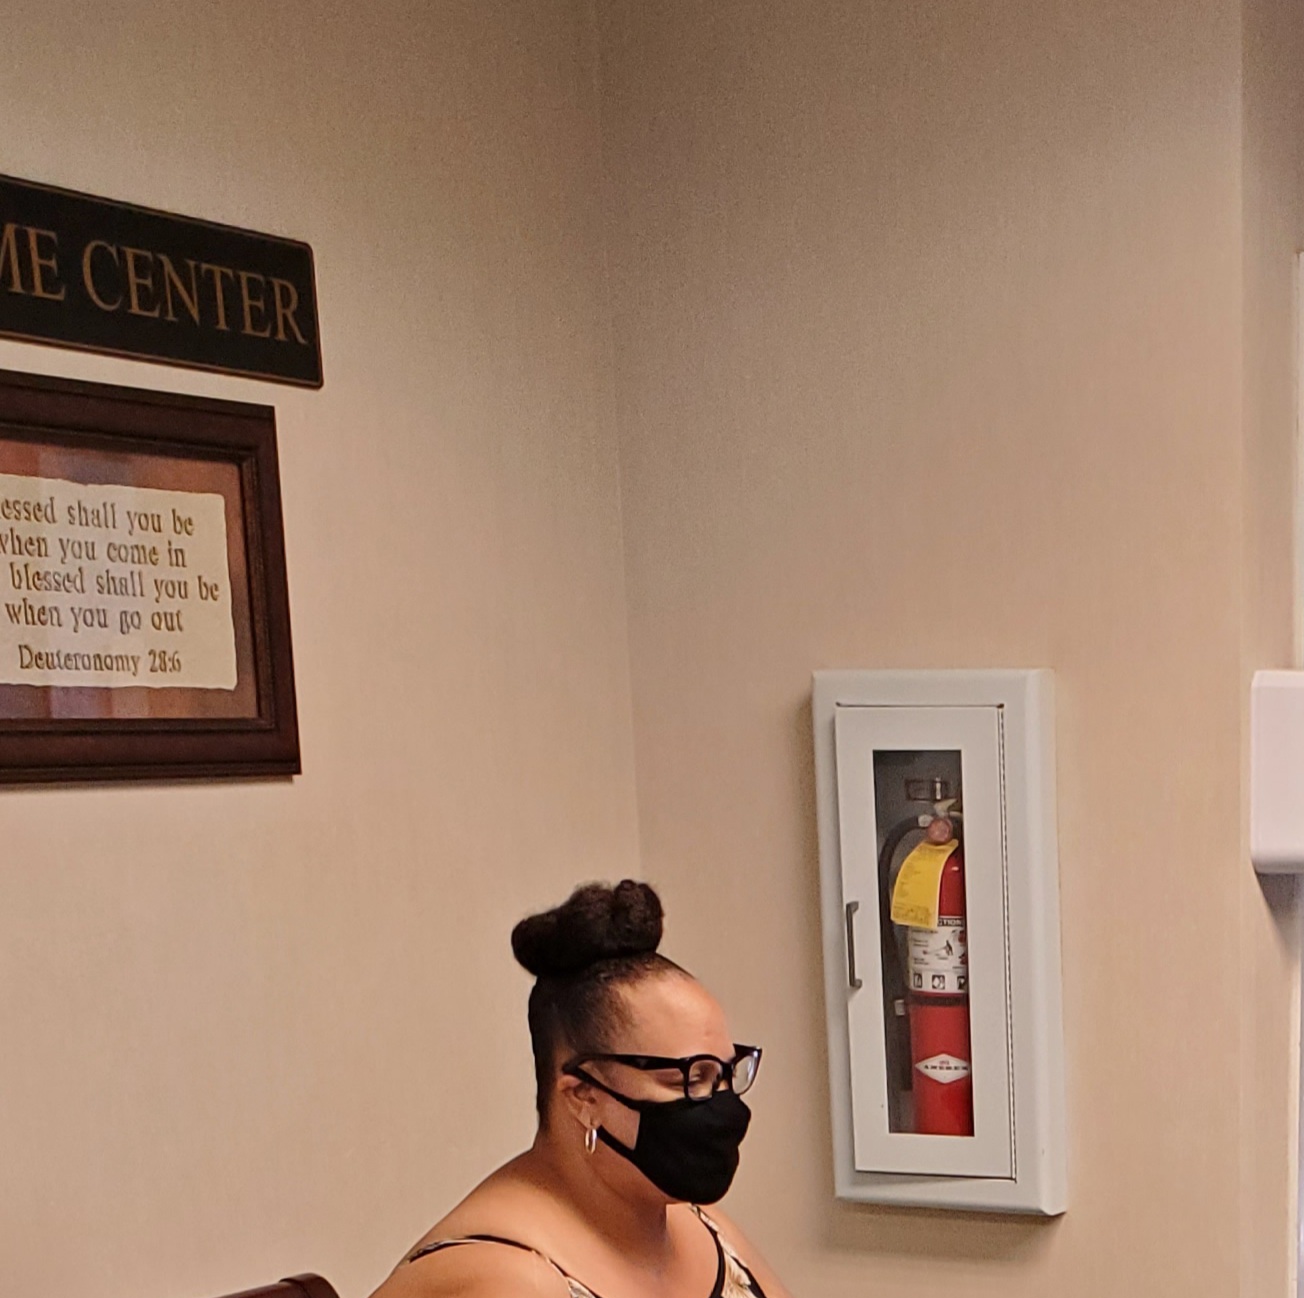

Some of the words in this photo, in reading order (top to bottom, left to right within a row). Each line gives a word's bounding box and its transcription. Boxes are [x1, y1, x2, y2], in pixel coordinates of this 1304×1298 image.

[82, 239, 308, 345] CENTER
[0, 496, 57, 524] essed
[67, 500, 117, 529] shall
[126, 510, 162, 536] you
[172, 508, 194, 536] be
[59, 538, 96, 564] you
[107, 542, 159, 566] come
[168, 539, 187, 568] in
[10, 562, 85, 594] blessed
[96, 568, 144, 597] shall
[154, 578, 188, 603] you
[197, 575, 219, 601] be
[5, 597, 62, 627] when
[70, 606, 109, 633] you
[120, 610, 142, 635] go
[151, 609, 183, 632] out
[18, 644, 141, 677] Deuteronomy
[148, 649, 182, 673] 28:6
